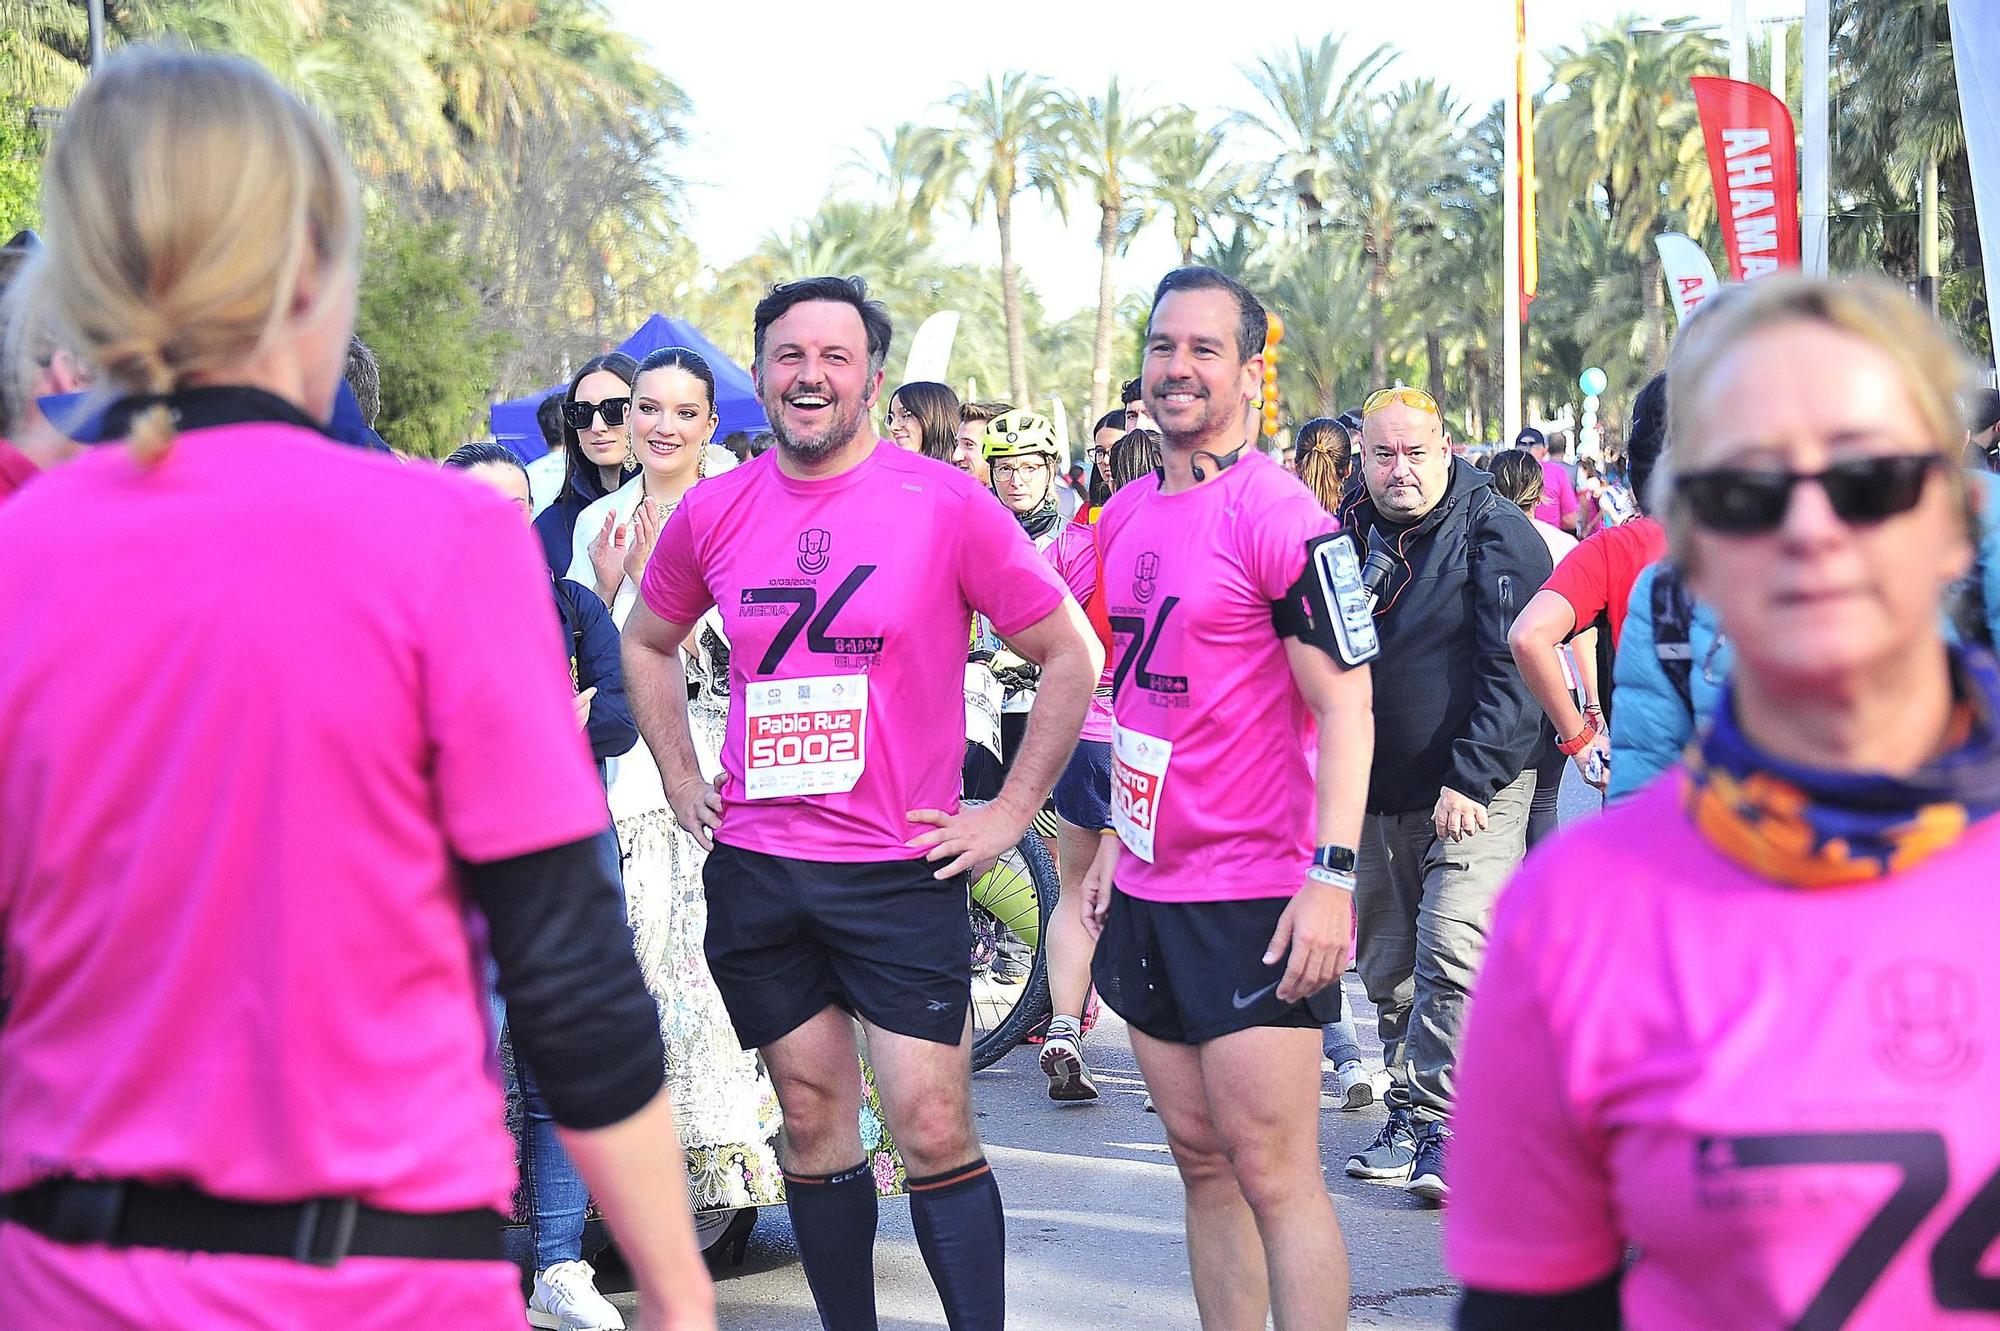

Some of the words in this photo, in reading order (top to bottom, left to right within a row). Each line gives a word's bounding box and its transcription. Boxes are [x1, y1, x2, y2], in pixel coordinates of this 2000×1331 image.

[739, 605, 790, 617] MEDIA
[757, 713, 810, 735] Pablo
[814, 712, 851, 731] Ruz
[752, 732, 855, 768] 5002
